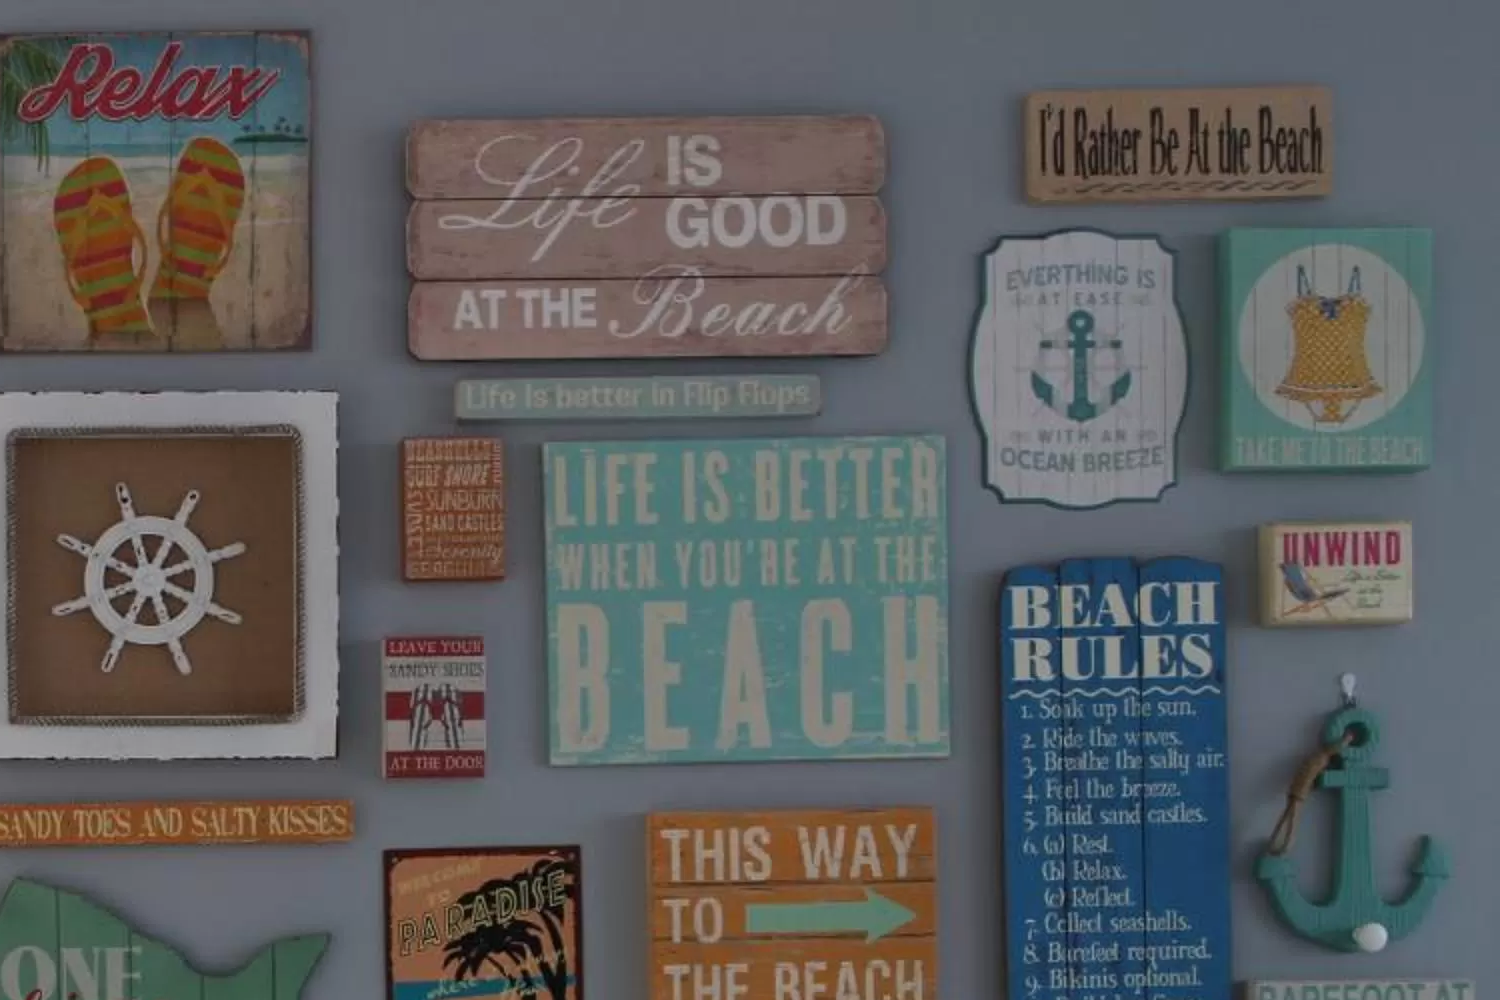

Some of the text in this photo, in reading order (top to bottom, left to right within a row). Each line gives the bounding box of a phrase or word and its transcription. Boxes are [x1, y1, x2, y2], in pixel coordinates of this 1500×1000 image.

[18, 41, 280, 122] Relax
[1039, 103, 1323, 179] I'd Rather Be At the Beach
[438, 134, 723, 262] Life IS
[665, 193, 847, 249] GOOD
[1137, 269, 1156, 289] IS
[454, 263, 869, 338] AT THE Beach
[466, 382, 516, 409] Life
[556, 383, 643, 408] better
[1000, 446, 1165, 473] OCEAN BREEZE
[554, 450, 660, 527] LIFE
[682, 449, 730, 524] IS
[755, 445, 938, 522] BETTER
[557, 535, 936, 591] WHEN YOU'RE AT THE
[1283, 531, 1401, 567] UNWIND
[1007, 581, 1221, 630] BEACH
[388, 640, 437, 654] LEAVE
[1010, 633, 1214, 681] RULES
[556, 594, 940, 753] BEACH
[1092, 704, 1117, 724] up
[1123, 696, 1152, 717] the
[1157, 700, 1197, 716] sun.
[1042, 726, 1084, 749] Ride
[1089, 725, 1118, 748] the
[391, 755, 484, 769] AT THE DOOR
[1044, 750, 1109, 772] Breathe
[1115, 749, 1143, 771] the
[1150, 749, 1190, 776] salty
[1197, 746, 1225, 768] air.
[1044, 777, 1079, 800] Feel
[1086, 776, 1114, 798] the
[73, 808, 132, 840] TOES
[138, 807, 183, 838] AND
[191, 805, 262, 838] SALTY
[268, 804, 349, 836] KISSES
[1045, 805, 1092, 826] Build
[1100, 803, 1142, 825] sand
[1148, 803, 1208, 824] castles.
[659, 823, 917, 882] THIS WAY
[1072, 860, 1128, 881] Relax.
[398, 869, 568, 957] PARADISE
[663, 896, 724, 944] TO
[1044, 911, 1102, 934] Collect
[1110, 909, 1192, 932] seashells.
[1128, 938, 1212, 970] required.
[1050, 968, 1118, 990] Bikinis
[1123, 965, 1203, 994] optional.
